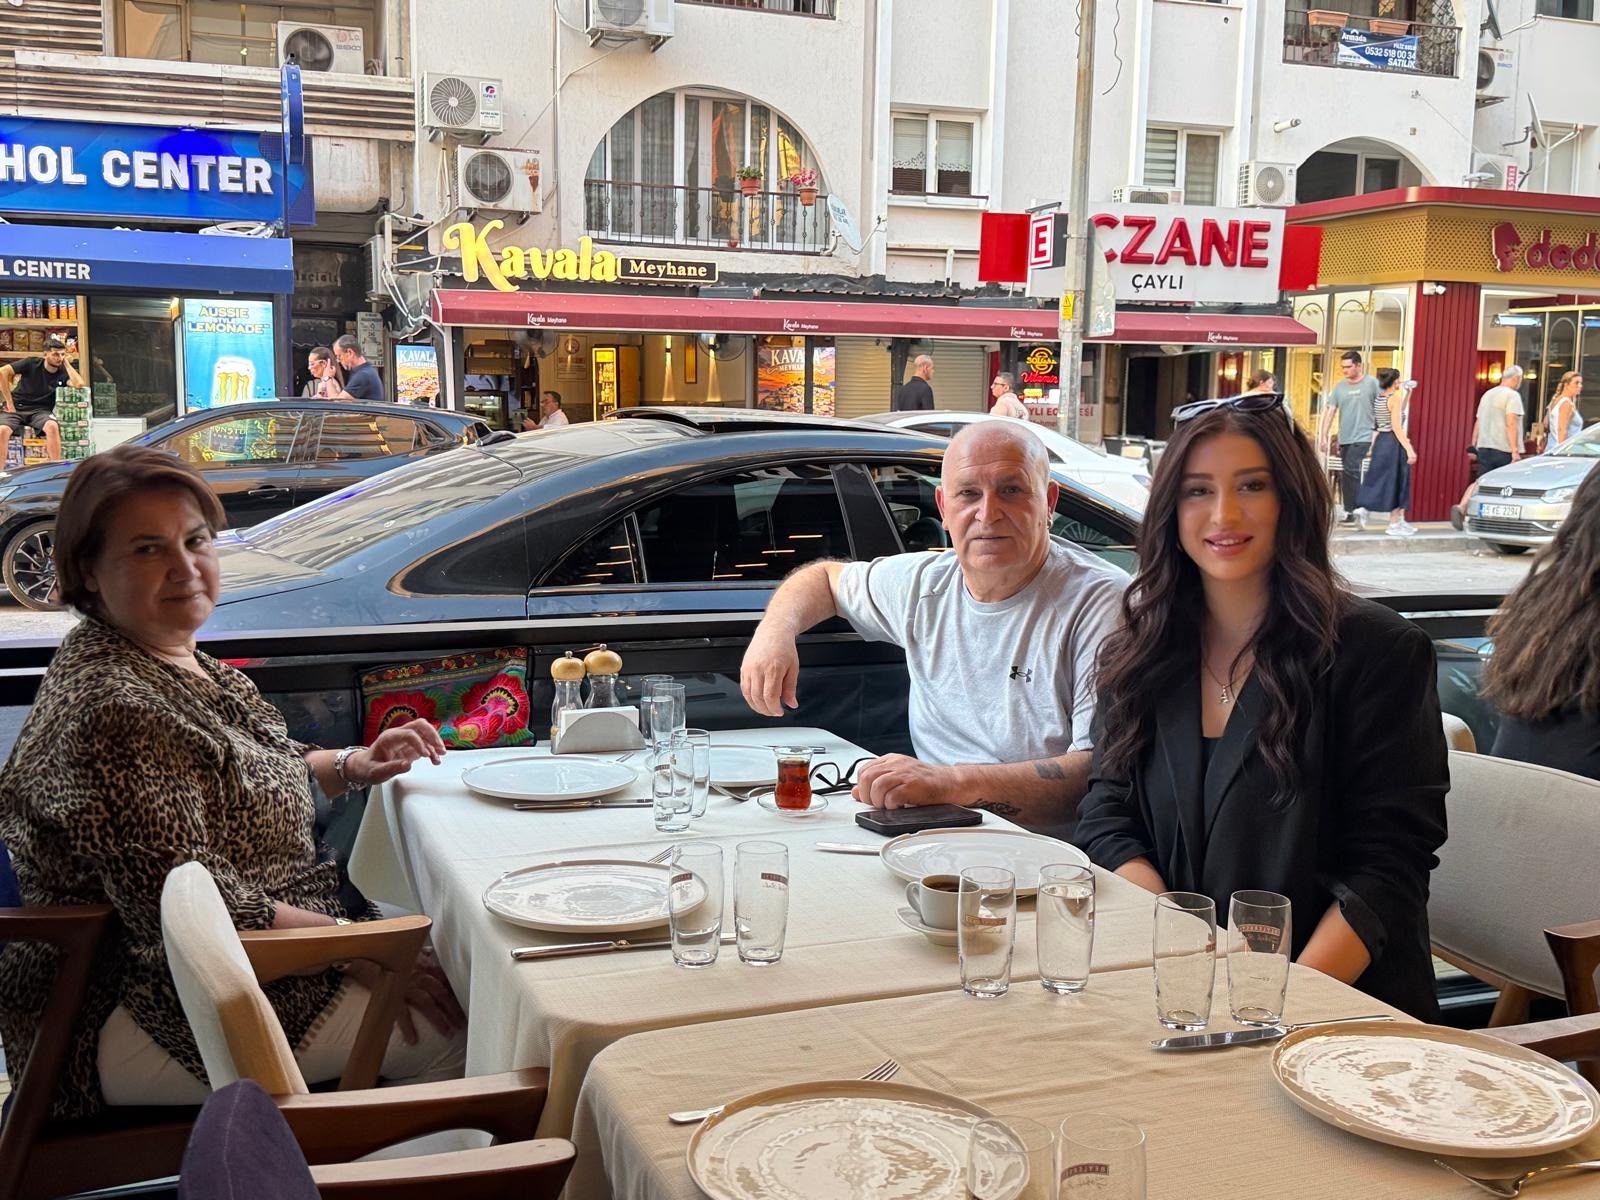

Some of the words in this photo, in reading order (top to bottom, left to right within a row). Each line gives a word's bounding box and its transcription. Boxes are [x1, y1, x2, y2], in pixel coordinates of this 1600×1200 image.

[1342, 32, 1367, 42] Armada
[1365, 47, 1383, 56] 0532
[1384, 49, 1396, 58] 518
[1397, 50, 1406, 58] 00
[102, 150, 274, 195] CENTER
[1034, 223, 1047, 257] E
[443, 219, 618, 293] Kavala
[629, 260, 707, 277] Meyhane
[1525, 230, 1600, 271] ded
[14, 260, 91, 281] CENTER
[1131, 273, 1183, 293] ÇAYLI
[199, 306, 249, 318] AUSSIE
[527, 312, 546, 326] Kavala
[783, 318, 800, 331] Kavala
[399, 350, 437, 362] KAVALA
[771, 349, 820, 366] KAVAA
